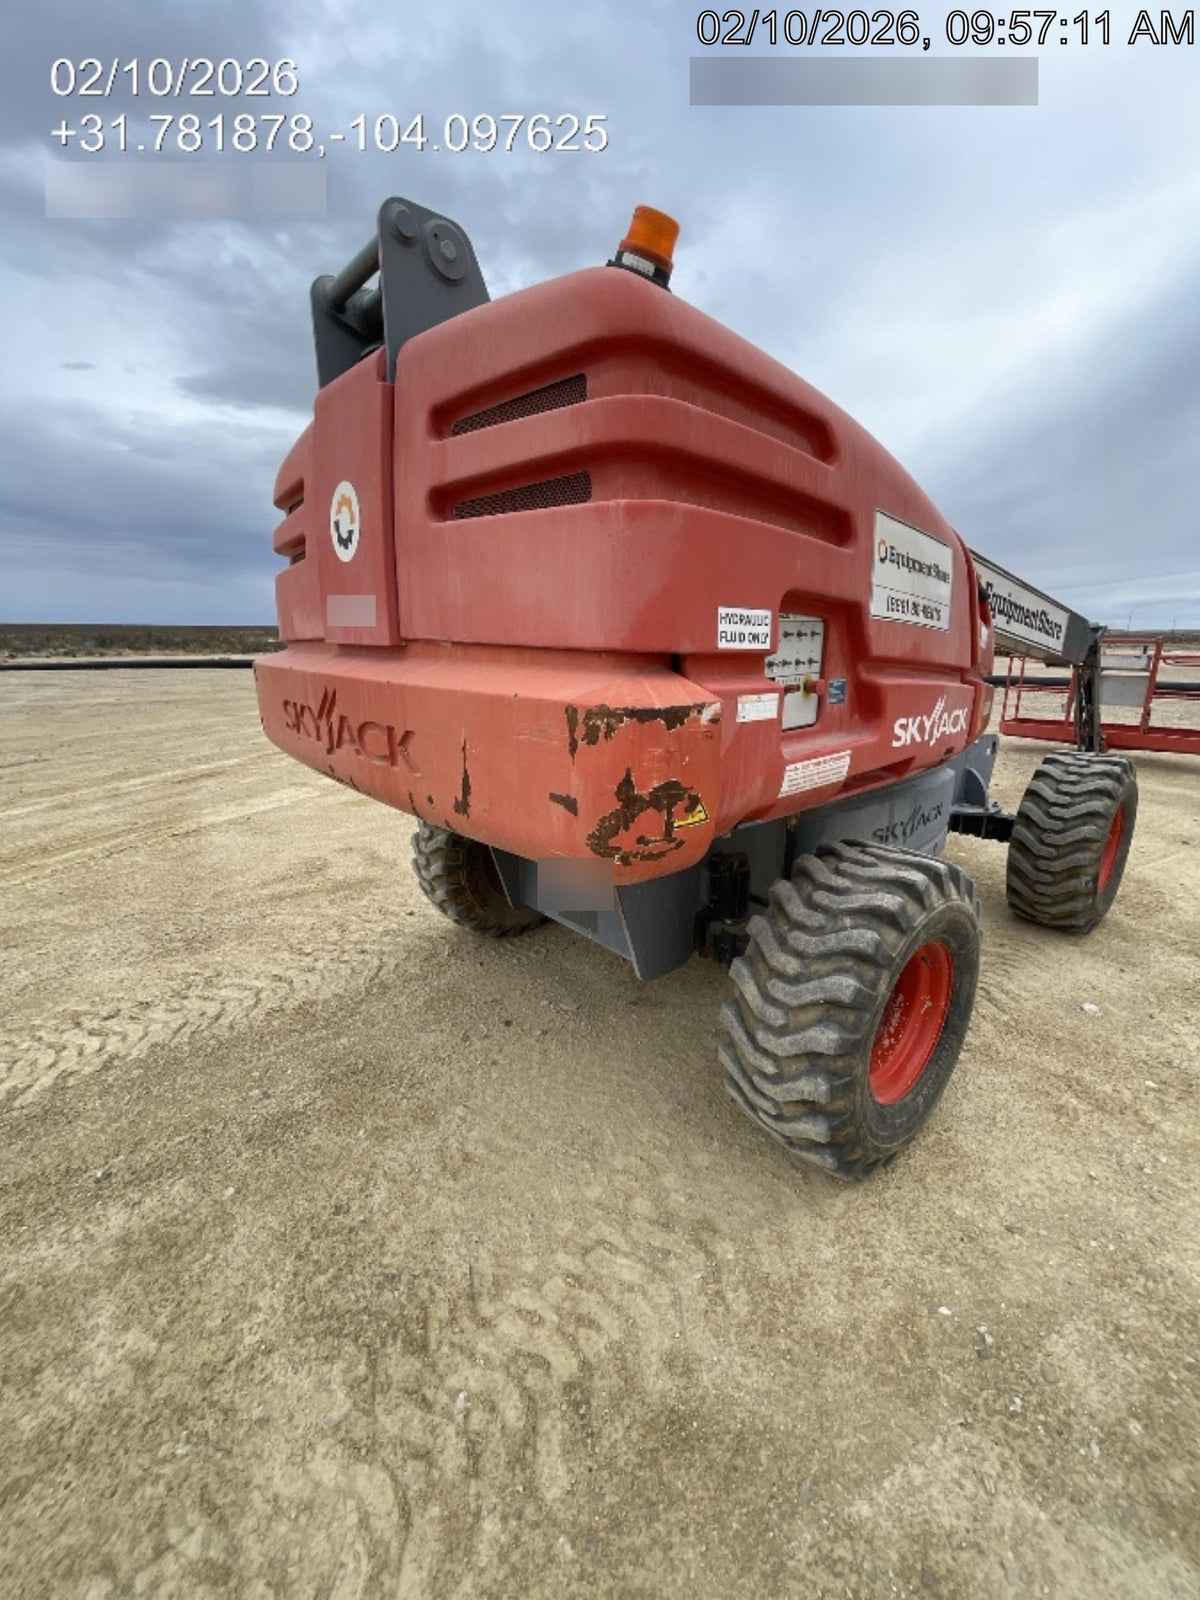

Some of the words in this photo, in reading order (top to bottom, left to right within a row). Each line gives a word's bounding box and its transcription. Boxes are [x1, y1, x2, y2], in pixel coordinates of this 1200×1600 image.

[719, 612, 769, 627] HYDRAULIC
[719, 630, 746, 644] FLUID
[748, 632, 769, 645] ONLY
[282, 686, 420, 776] SKYJACK
[892, 694, 968, 748] SKYJACK
[872, 806, 944, 844] SKYJACK
